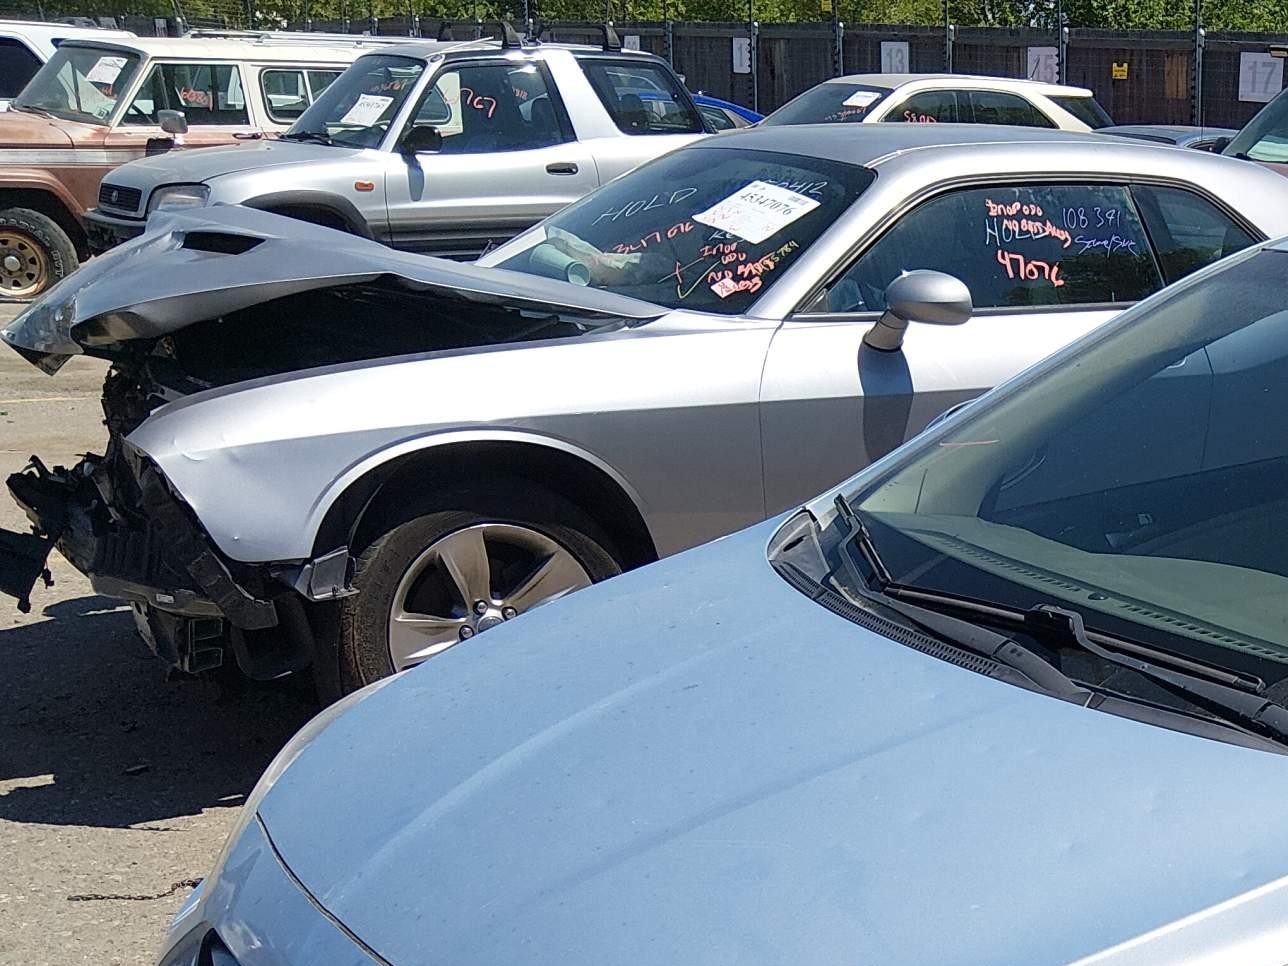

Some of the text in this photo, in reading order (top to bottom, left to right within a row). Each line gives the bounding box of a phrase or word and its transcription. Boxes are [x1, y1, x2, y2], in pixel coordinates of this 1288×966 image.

[1247, 61, 1281, 93] 17
[591, 187, 698, 226] HOLD
[1062, 207, 1089, 229] 108
[997, 249, 1065, 288] 47076
